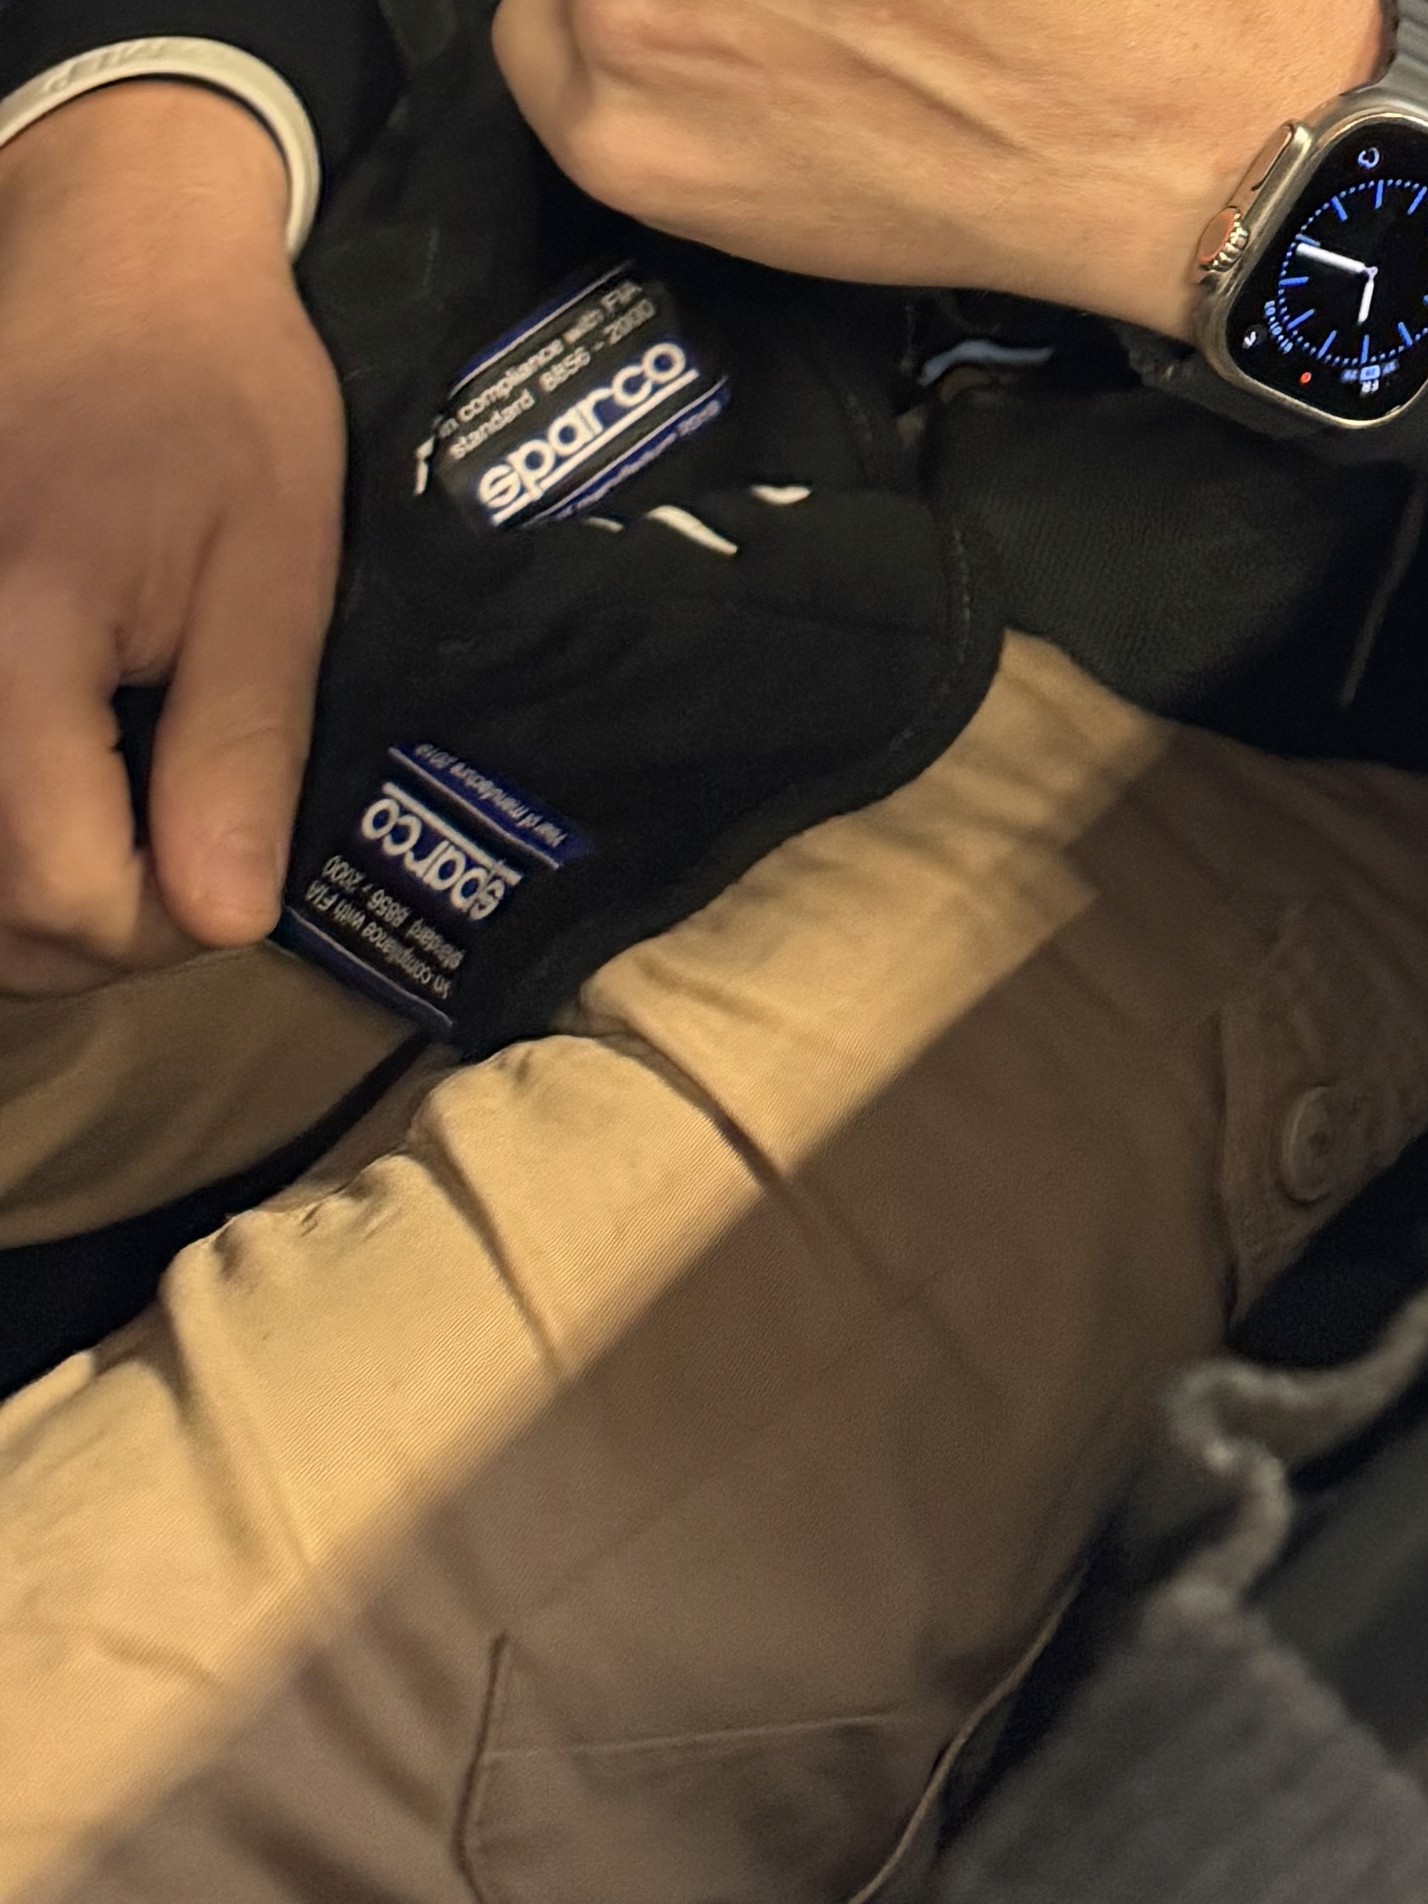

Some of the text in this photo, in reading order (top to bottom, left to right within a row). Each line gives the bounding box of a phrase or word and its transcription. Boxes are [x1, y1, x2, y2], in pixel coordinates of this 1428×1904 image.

[457, 339, 564, 422] compliance
[448, 388, 536, 460] standard
[479, 342, 687, 508] sparco
[305, 878, 336, 911] FIA
[361, 798, 506, 921] sparco
[333, 900, 368, 933] with
[362, 921, 433, 984] compliance
